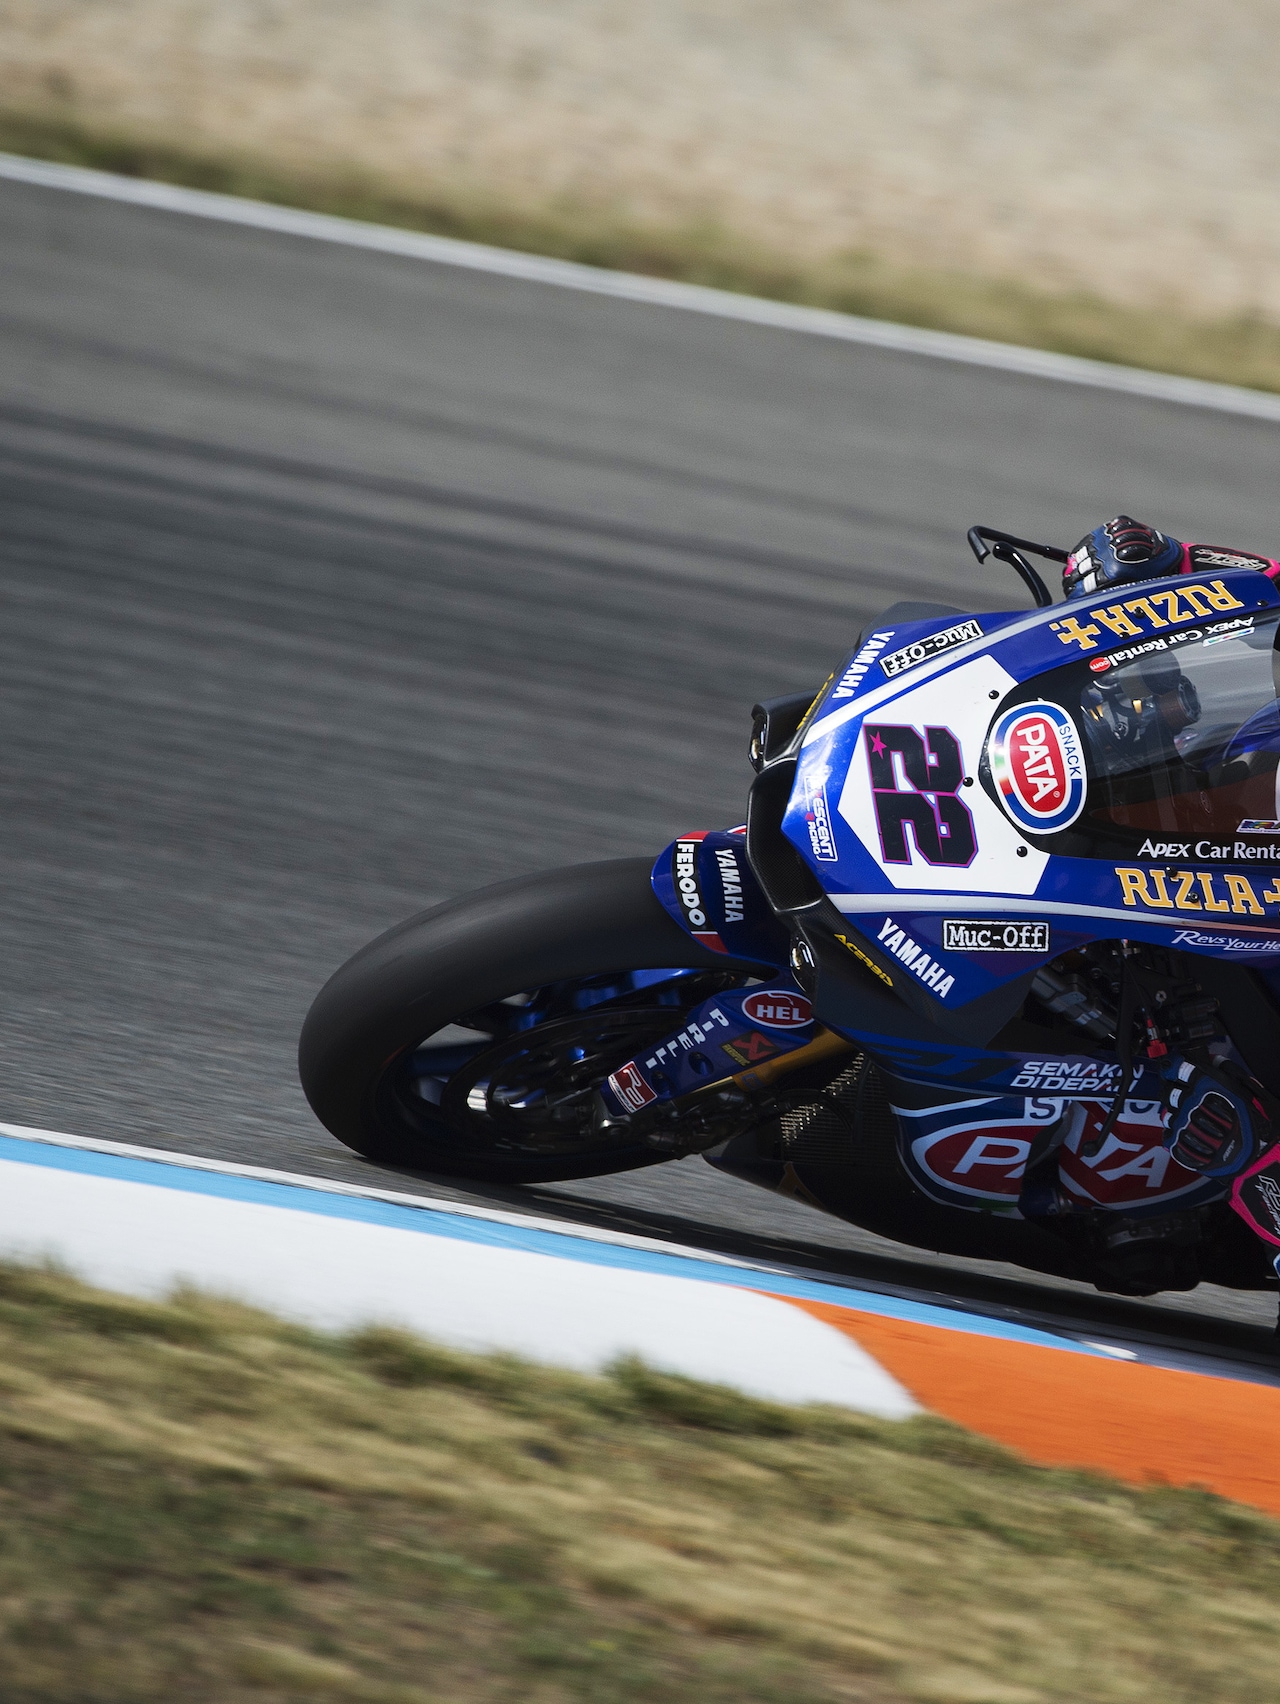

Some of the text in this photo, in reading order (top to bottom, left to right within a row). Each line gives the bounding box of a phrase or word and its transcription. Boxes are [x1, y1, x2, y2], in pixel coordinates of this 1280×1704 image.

[885, 622, 979, 674] Muc-Off
[1169, 629, 1203, 645] Car
[1205, 617, 1255, 634] APEX
[832, 631, 895, 698] YAMAHA
[1016, 723, 1059, 803] PATA
[1060, 725, 1082, 776] SNACK
[862, 722, 979, 868] 22
[1137, 838, 1191, 858] APEX
[1195, 840, 1231, 859] Car
[676, 843, 706, 926] FERODO
[715, 849, 744, 923] YAMAHA
[877, 917, 956, 999] YAMAHA
[947, 925, 1044, 949] Muc-Off
[1171, 929, 1228, 947] Revs
[645, 1007, 730, 1069] PIRELLI
[756, 1004, 806, 1022] HEL
[1020, 1061, 1145, 1079] SEMAKN
